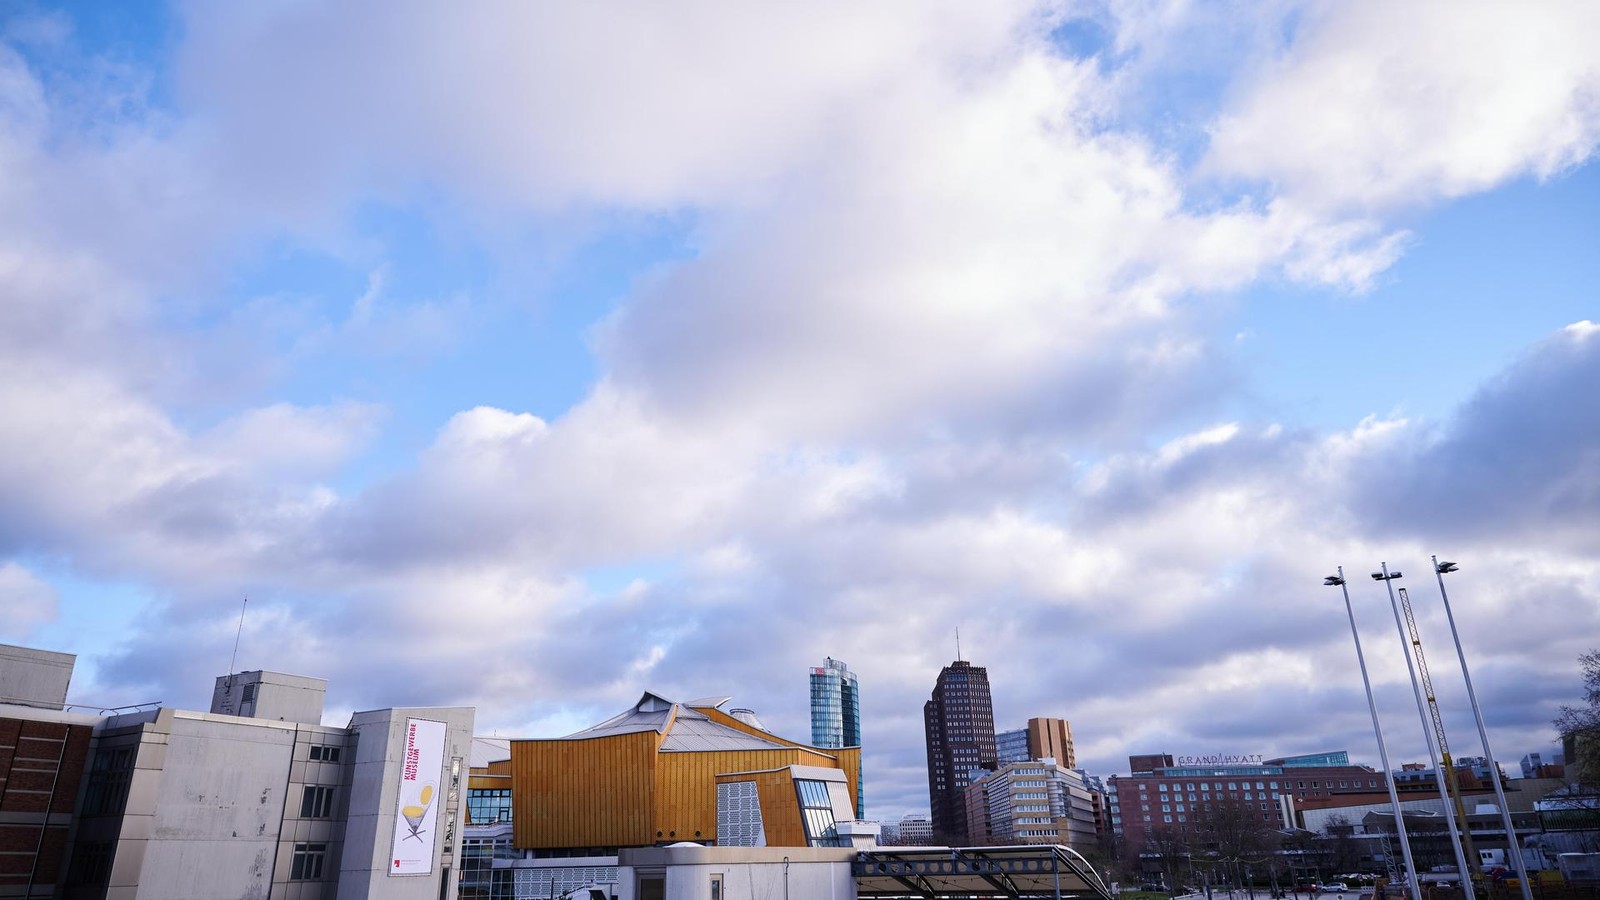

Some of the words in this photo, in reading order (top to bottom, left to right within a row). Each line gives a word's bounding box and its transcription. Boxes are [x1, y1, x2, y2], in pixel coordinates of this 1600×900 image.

[404, 723, 417, 780] KUNSTGEWERBE
[410, 748, 420, 781] MUSEUM
[1178, 755, 1218, 765] GRAND
[1224, 754, 1263, 763] HYATT
